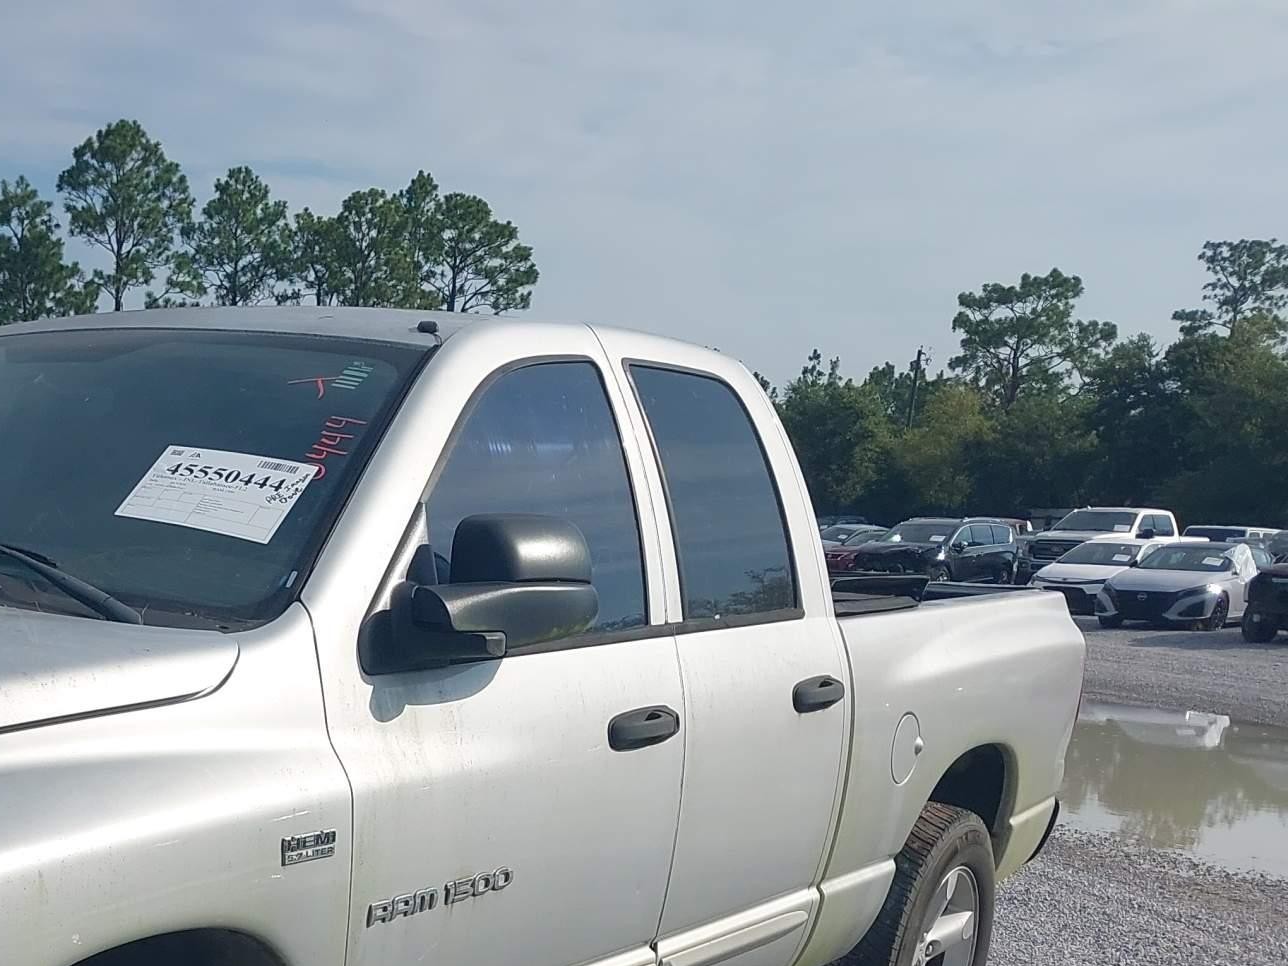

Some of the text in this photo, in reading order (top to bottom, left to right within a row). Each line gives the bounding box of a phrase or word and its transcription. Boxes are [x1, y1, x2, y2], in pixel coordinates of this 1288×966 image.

[167, 462, 286, 492] 45550444
[281, 830, 337, 853] HEMI
[305, 846, 335, 858] LITER
[366, 866, 514, 929] RAM 1500
